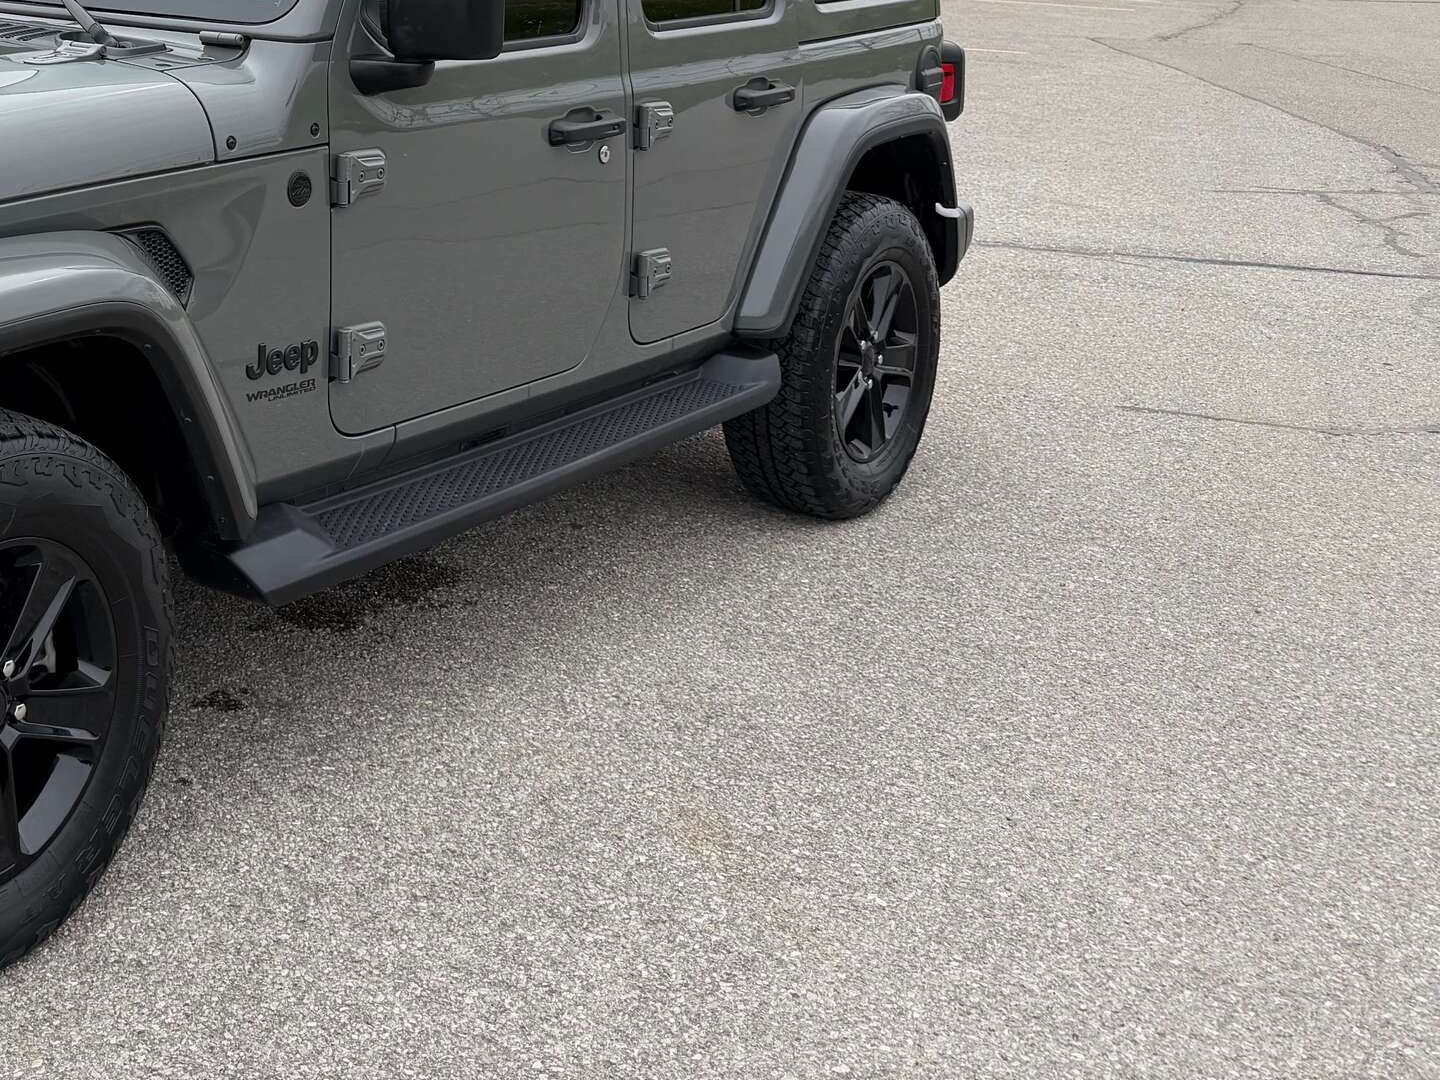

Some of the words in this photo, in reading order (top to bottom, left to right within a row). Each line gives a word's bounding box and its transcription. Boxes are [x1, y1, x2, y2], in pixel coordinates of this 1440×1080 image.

[246, 340, 319, 380] Jeep
[245, 378, 317, 403] WRANGLER
[267, 386, 317, 402] UNLIMITED
